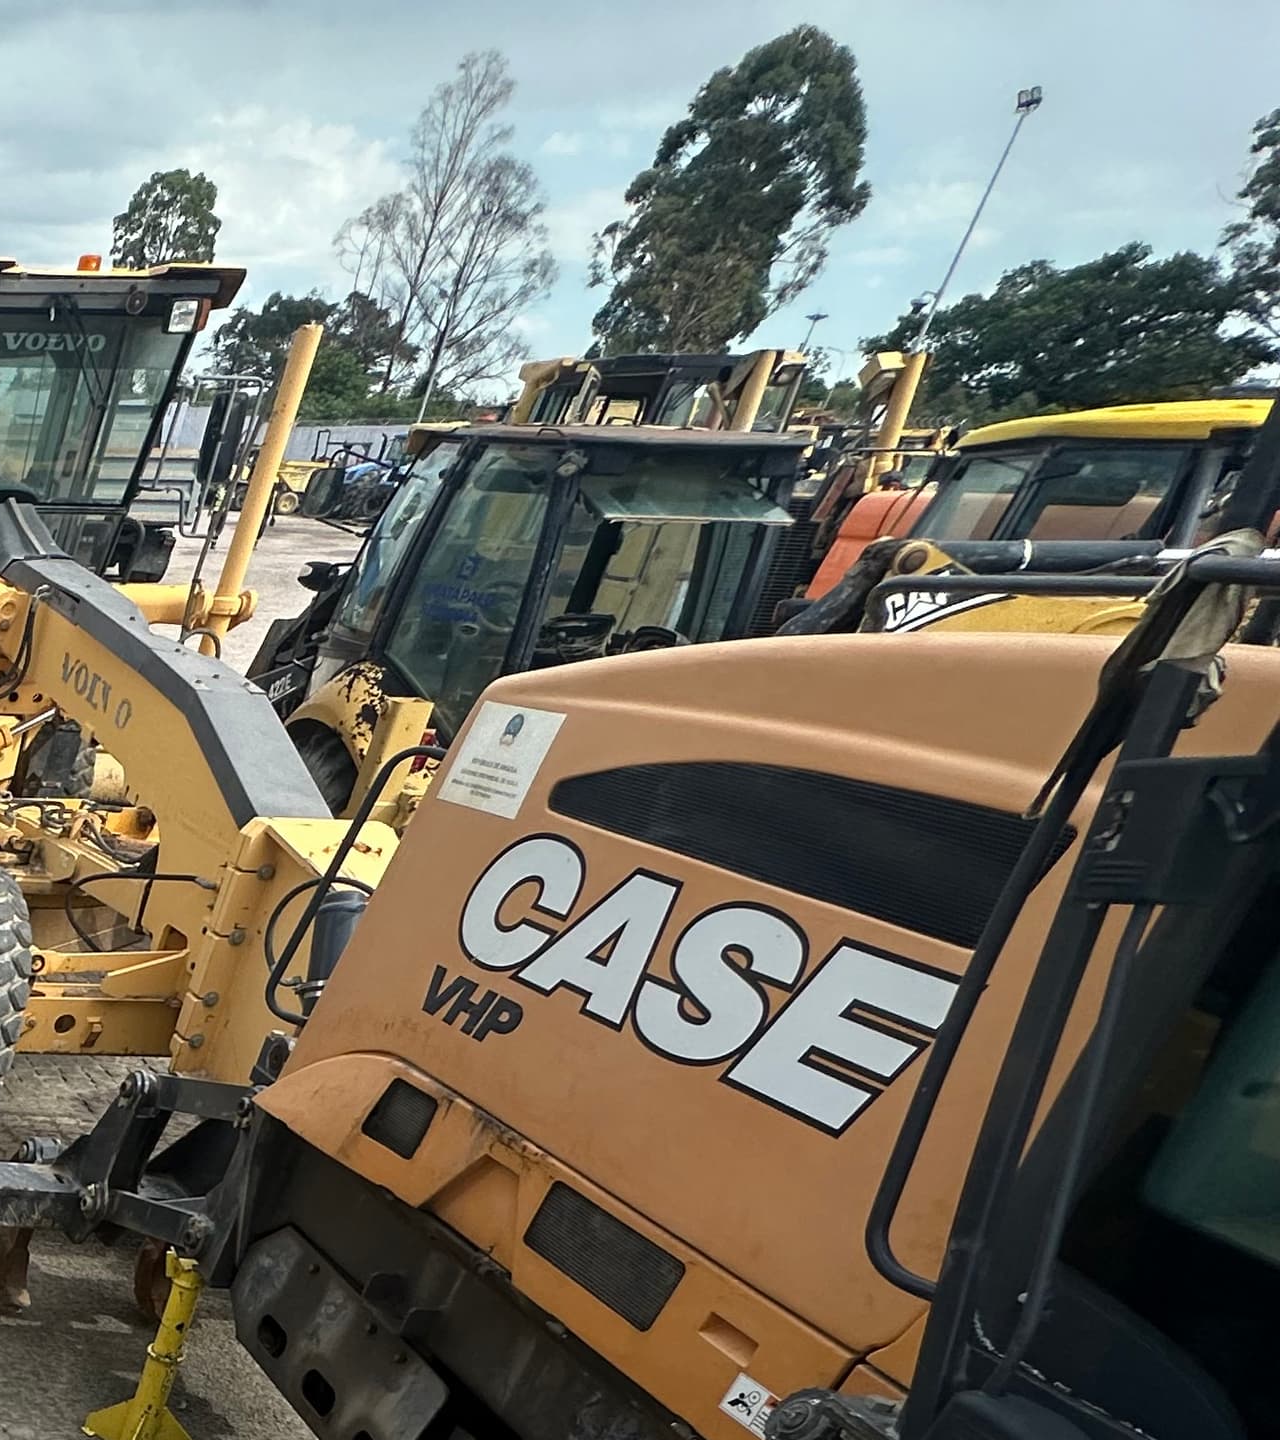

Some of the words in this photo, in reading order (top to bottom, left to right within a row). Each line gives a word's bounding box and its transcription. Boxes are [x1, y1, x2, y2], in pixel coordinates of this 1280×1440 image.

[2, 332, 107, 352] VOLVO
[422, 964, 524, 1042] VHP
[458, 832, 968, 1138] CASE
